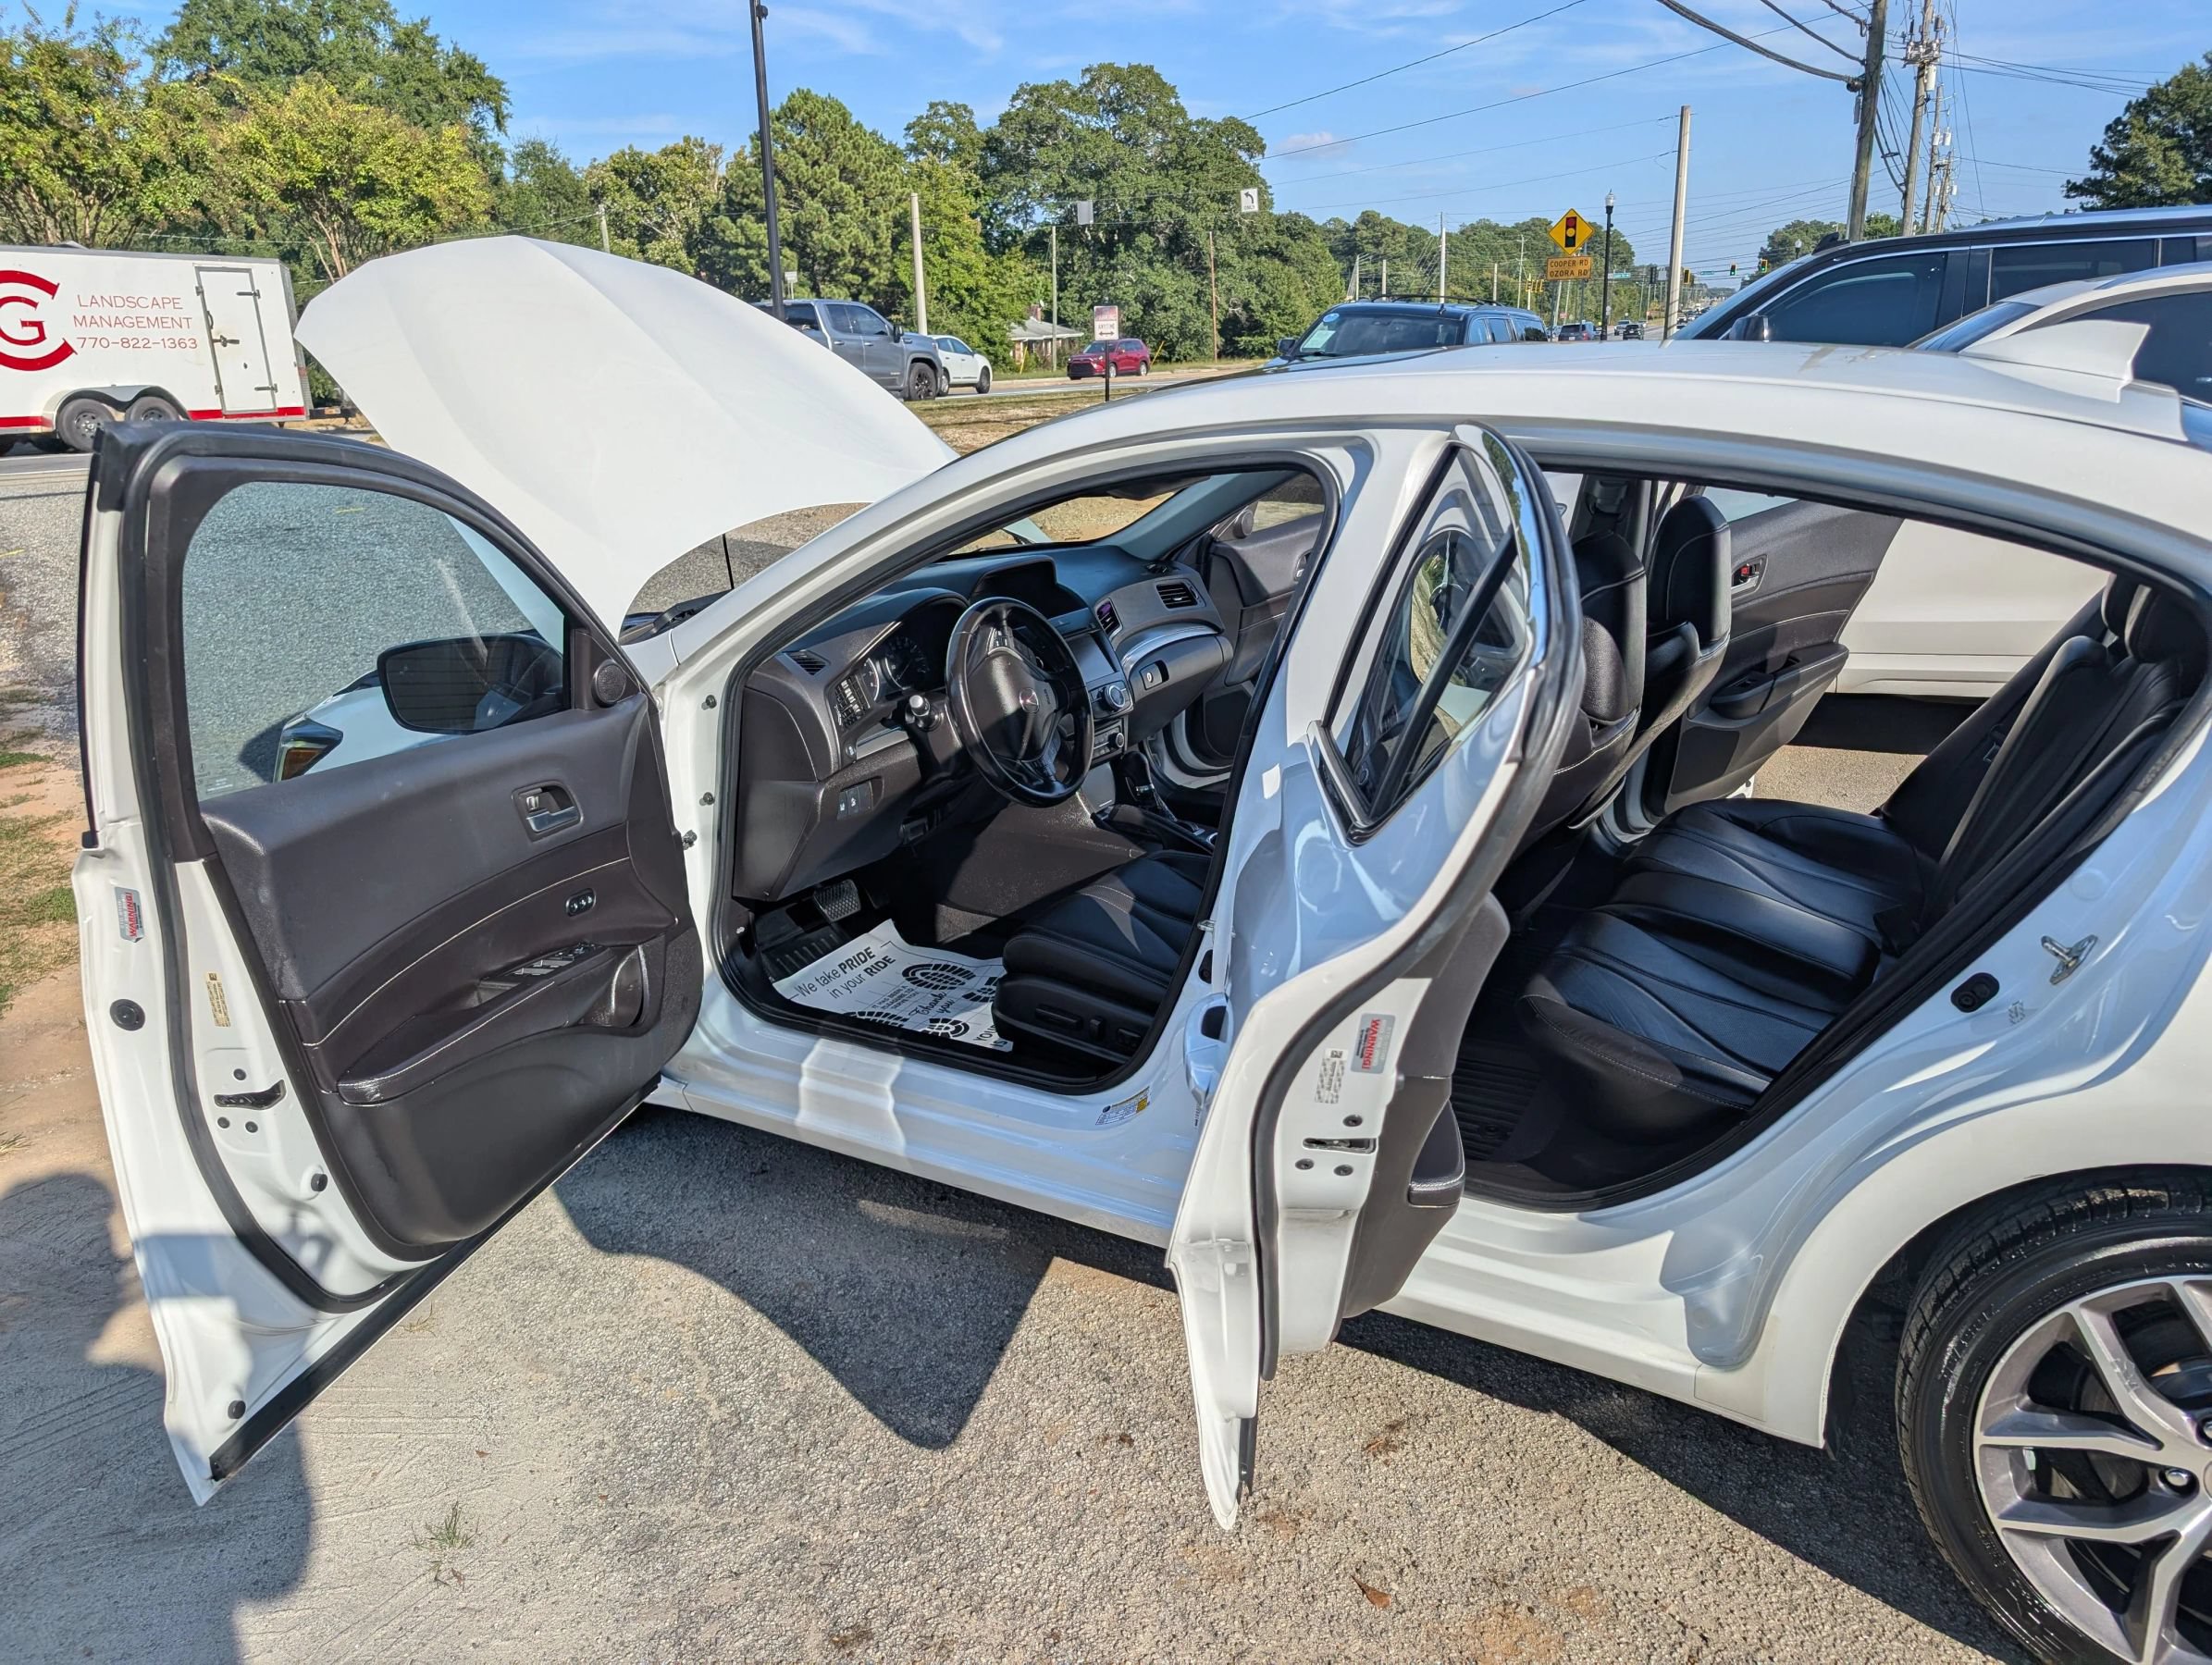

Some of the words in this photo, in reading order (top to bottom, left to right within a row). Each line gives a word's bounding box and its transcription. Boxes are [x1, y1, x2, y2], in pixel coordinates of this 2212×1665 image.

[77, 294, 183, 310] LANDSCAPE
[73, 314, 192, 329] MANAGEMENT
[76, 336, 198, 350] 770-822-1363
[126, 892, 137, 936] WARNING!
[795, 982, 818, 997] We
[814, 969, 841, 987] take
[837, 946, 876, 974] PRIDE
[826, 988, 844, 999] in
[840, 973, 866, 994] your
[863, 956, 896, 977] RIDE
[908, 991, 947, 1016] Thank
[936, 999, 956, 1014] you
